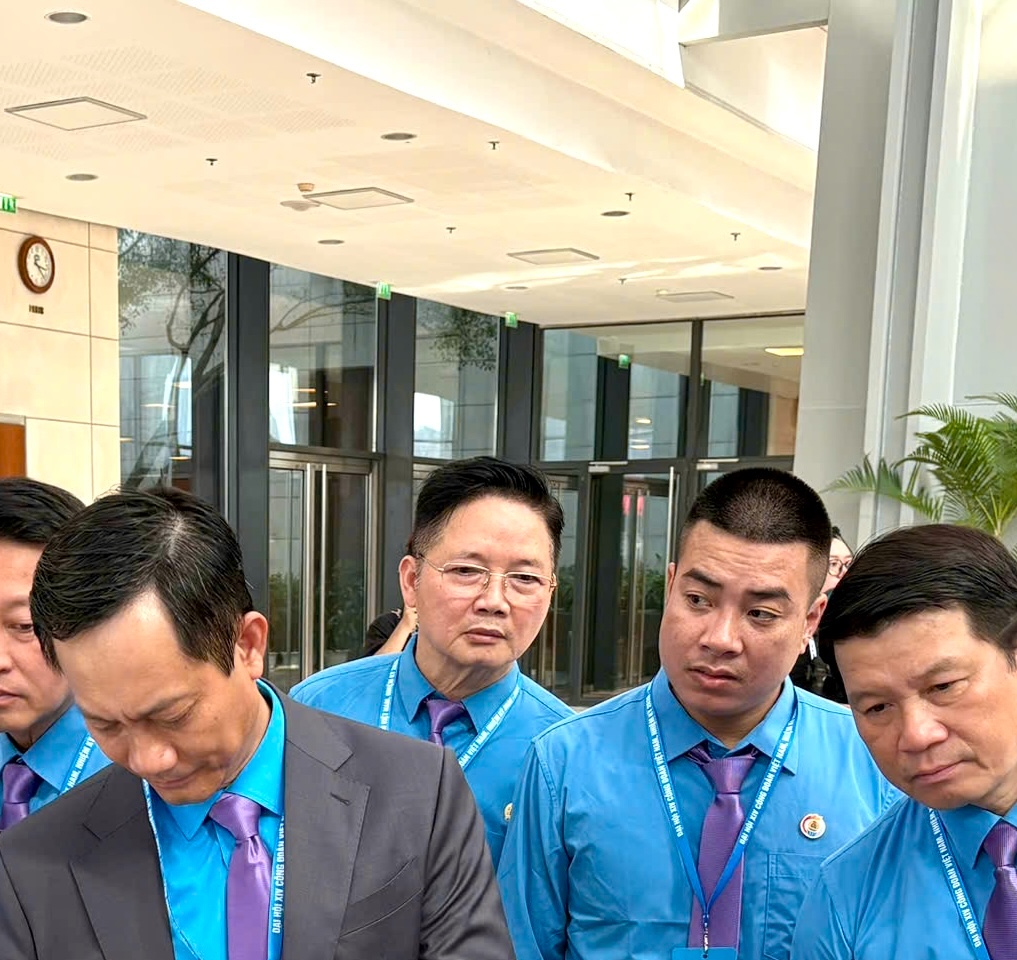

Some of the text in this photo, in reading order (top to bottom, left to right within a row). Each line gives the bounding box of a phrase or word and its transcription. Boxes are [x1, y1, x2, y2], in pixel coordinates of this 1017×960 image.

[459, 753, 471, 767] OÀN
[274, 864, 284, 887] CÔNG
[274, 888, 284, 902] XIV
[272, 903, 283, 917] HỘI
